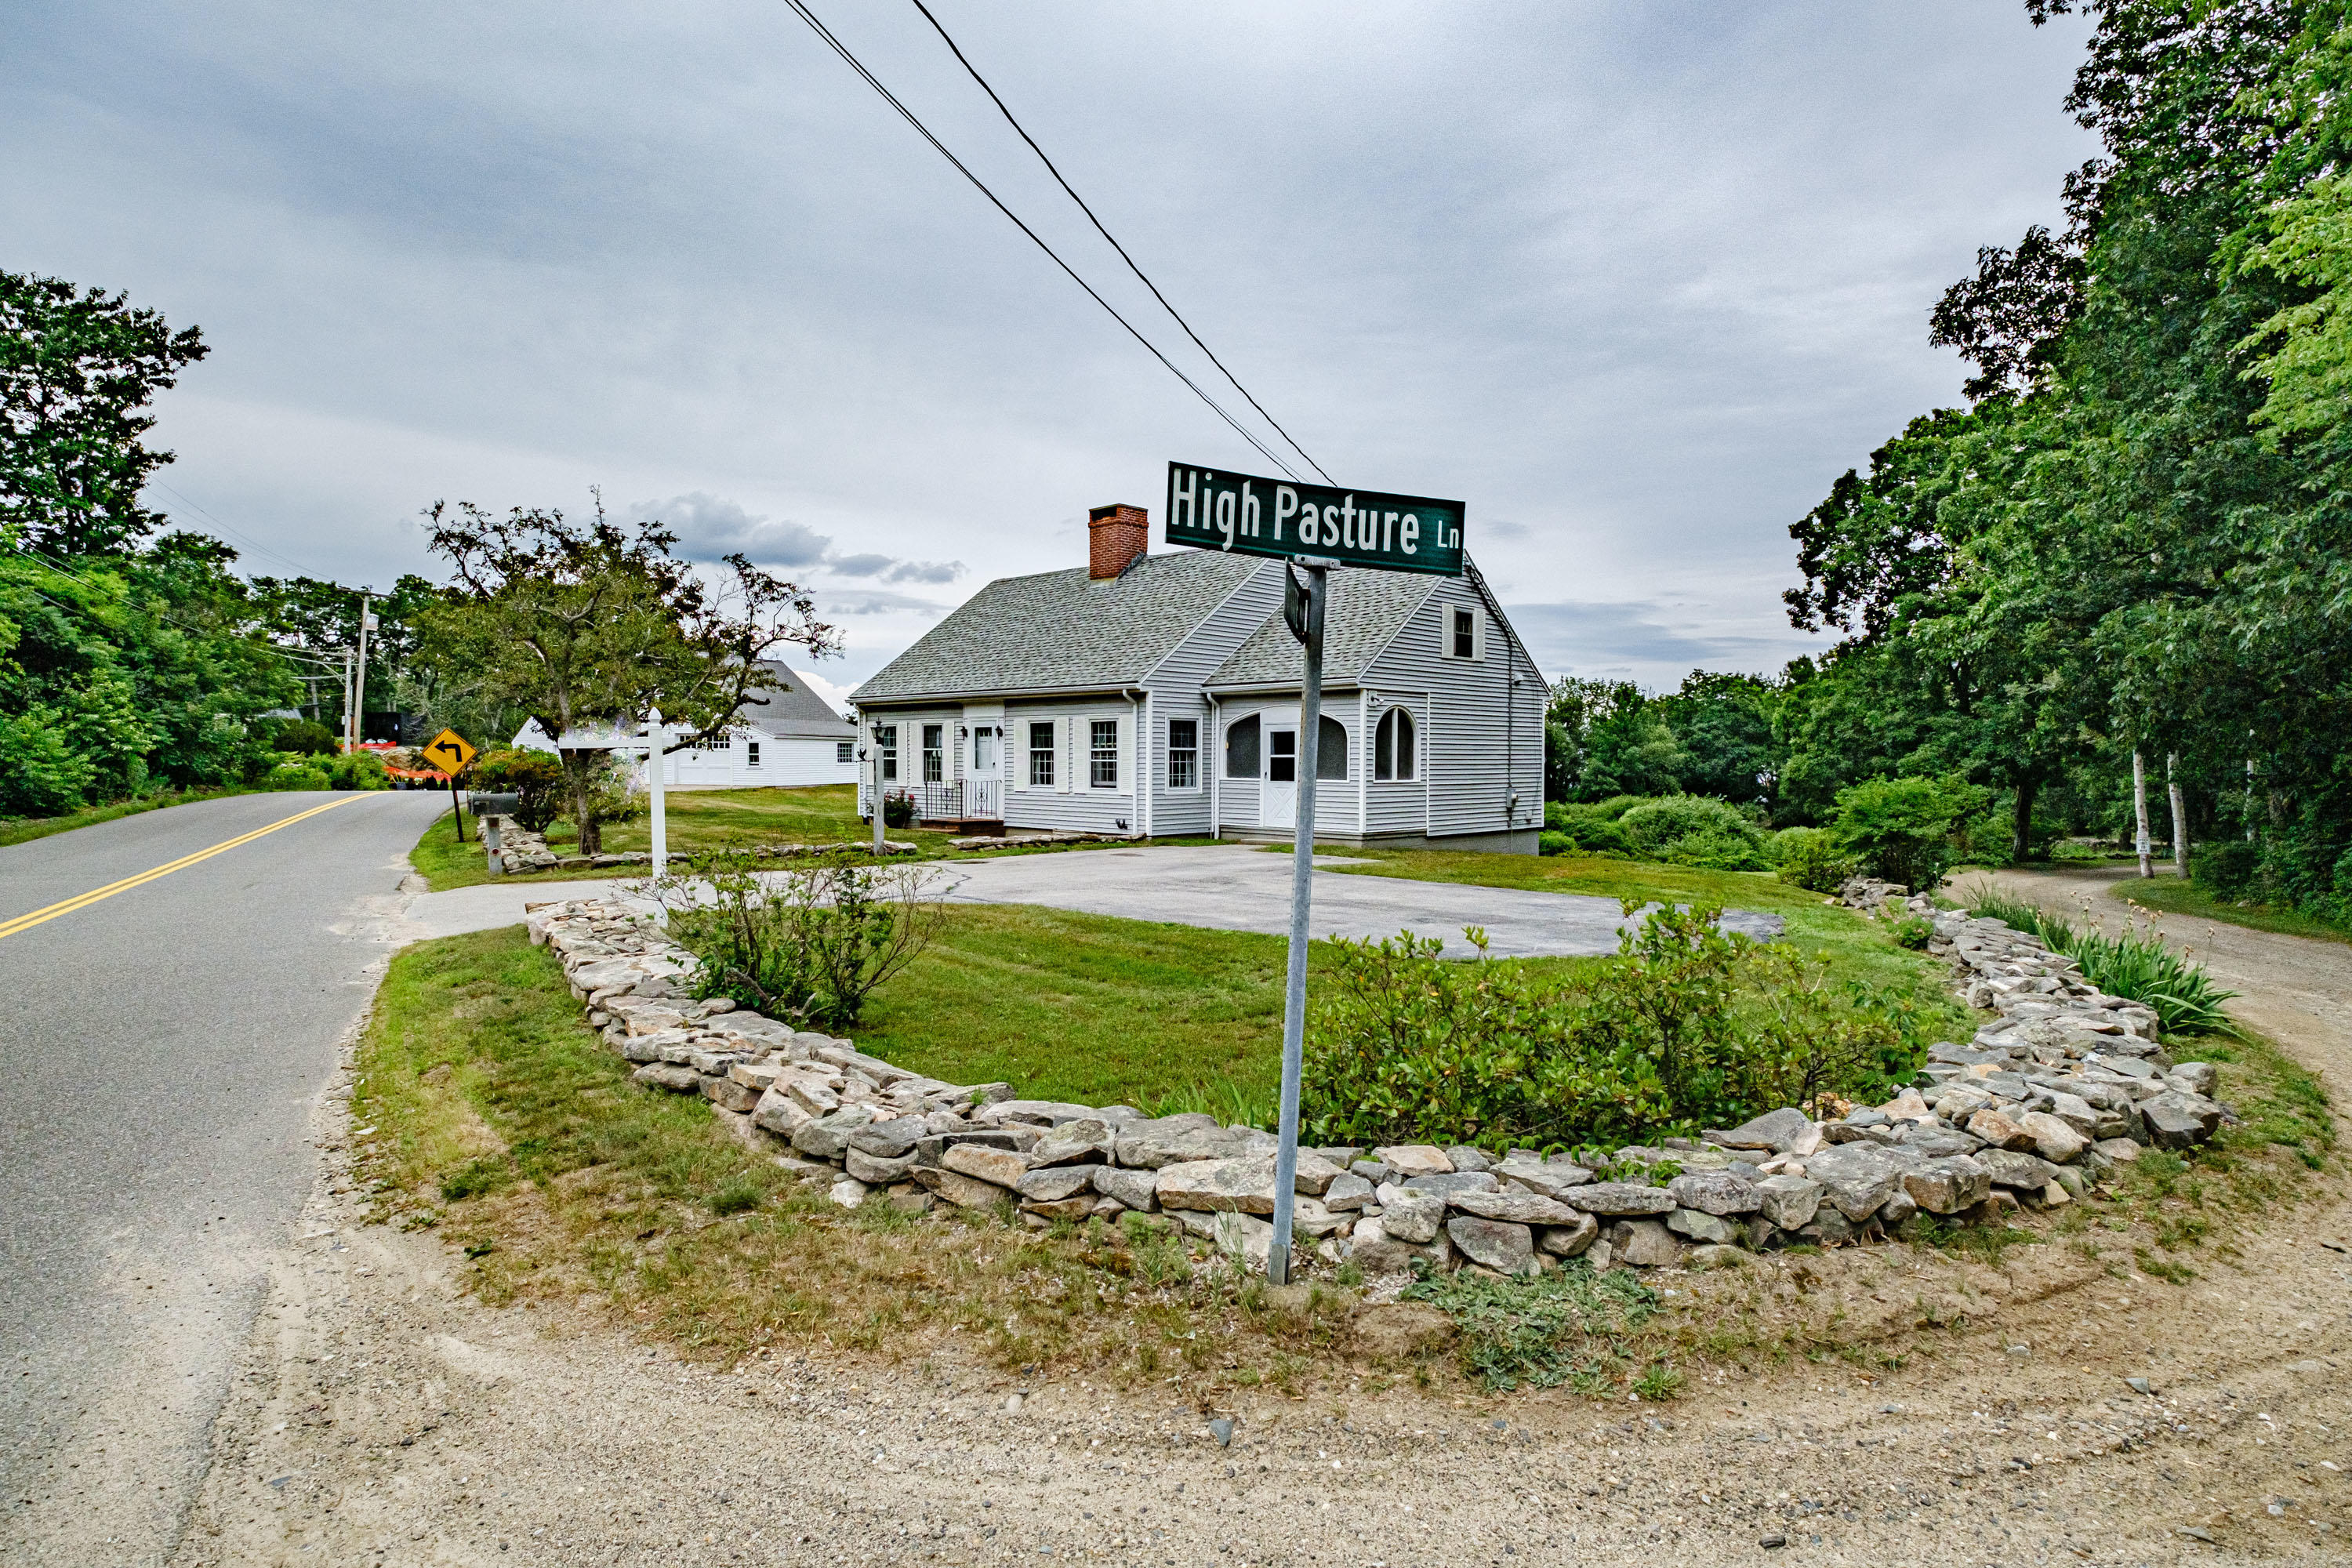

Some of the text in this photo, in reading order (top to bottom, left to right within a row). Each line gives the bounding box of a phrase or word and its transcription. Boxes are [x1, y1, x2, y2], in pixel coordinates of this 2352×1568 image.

[1171, 468, 1459, 554] High Pasture Ln
